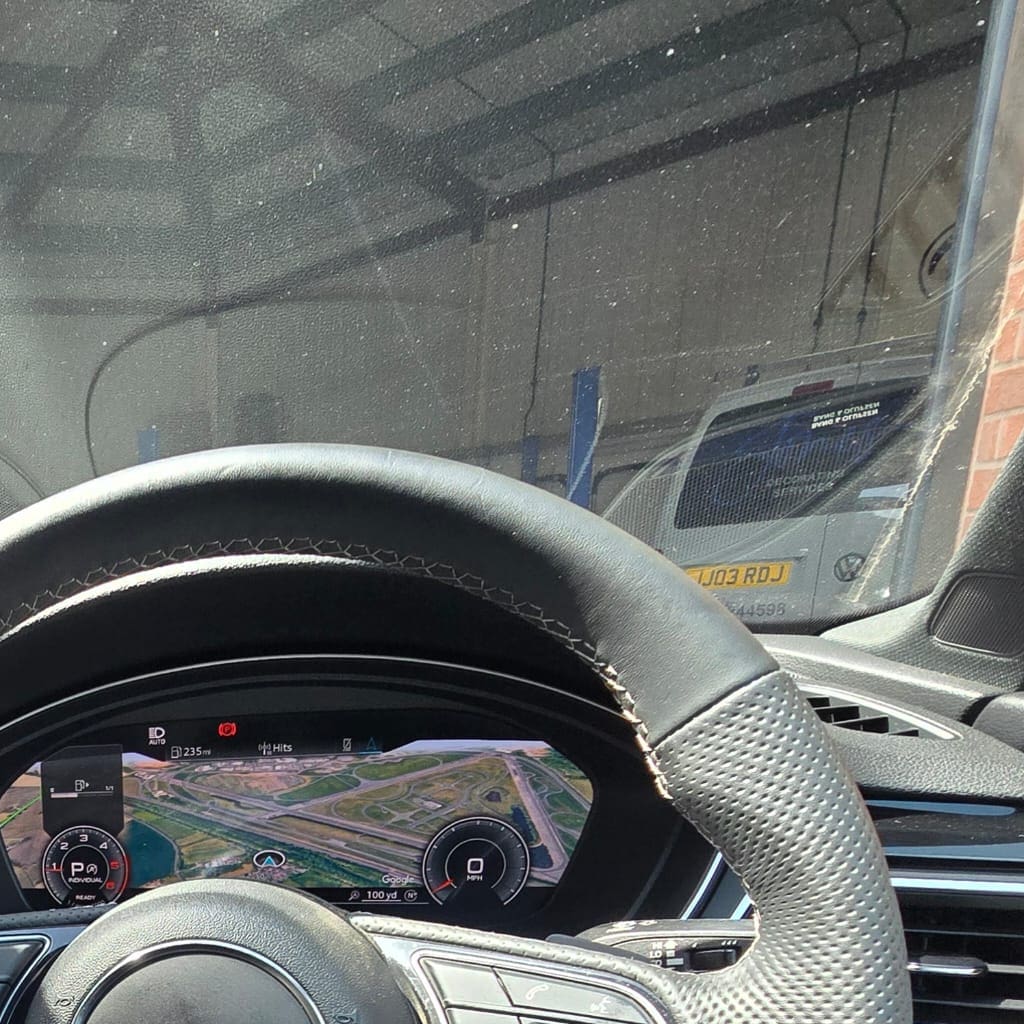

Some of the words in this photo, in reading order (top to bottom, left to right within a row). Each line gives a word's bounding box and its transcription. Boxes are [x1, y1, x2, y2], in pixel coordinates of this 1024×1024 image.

[743, 565, 785, 584] RDJ
[183, 747, 202, 756] 235
[273, 743, 293, 752] Hits
[79, 834, 88, 842] 3
[60, 842, 69, 850] 2
[71, 862, 84, 876] P
[382, 874, 415, 886] Google
[367, 891, 384, 899] 100
[385, 891, 397, 900] yd
